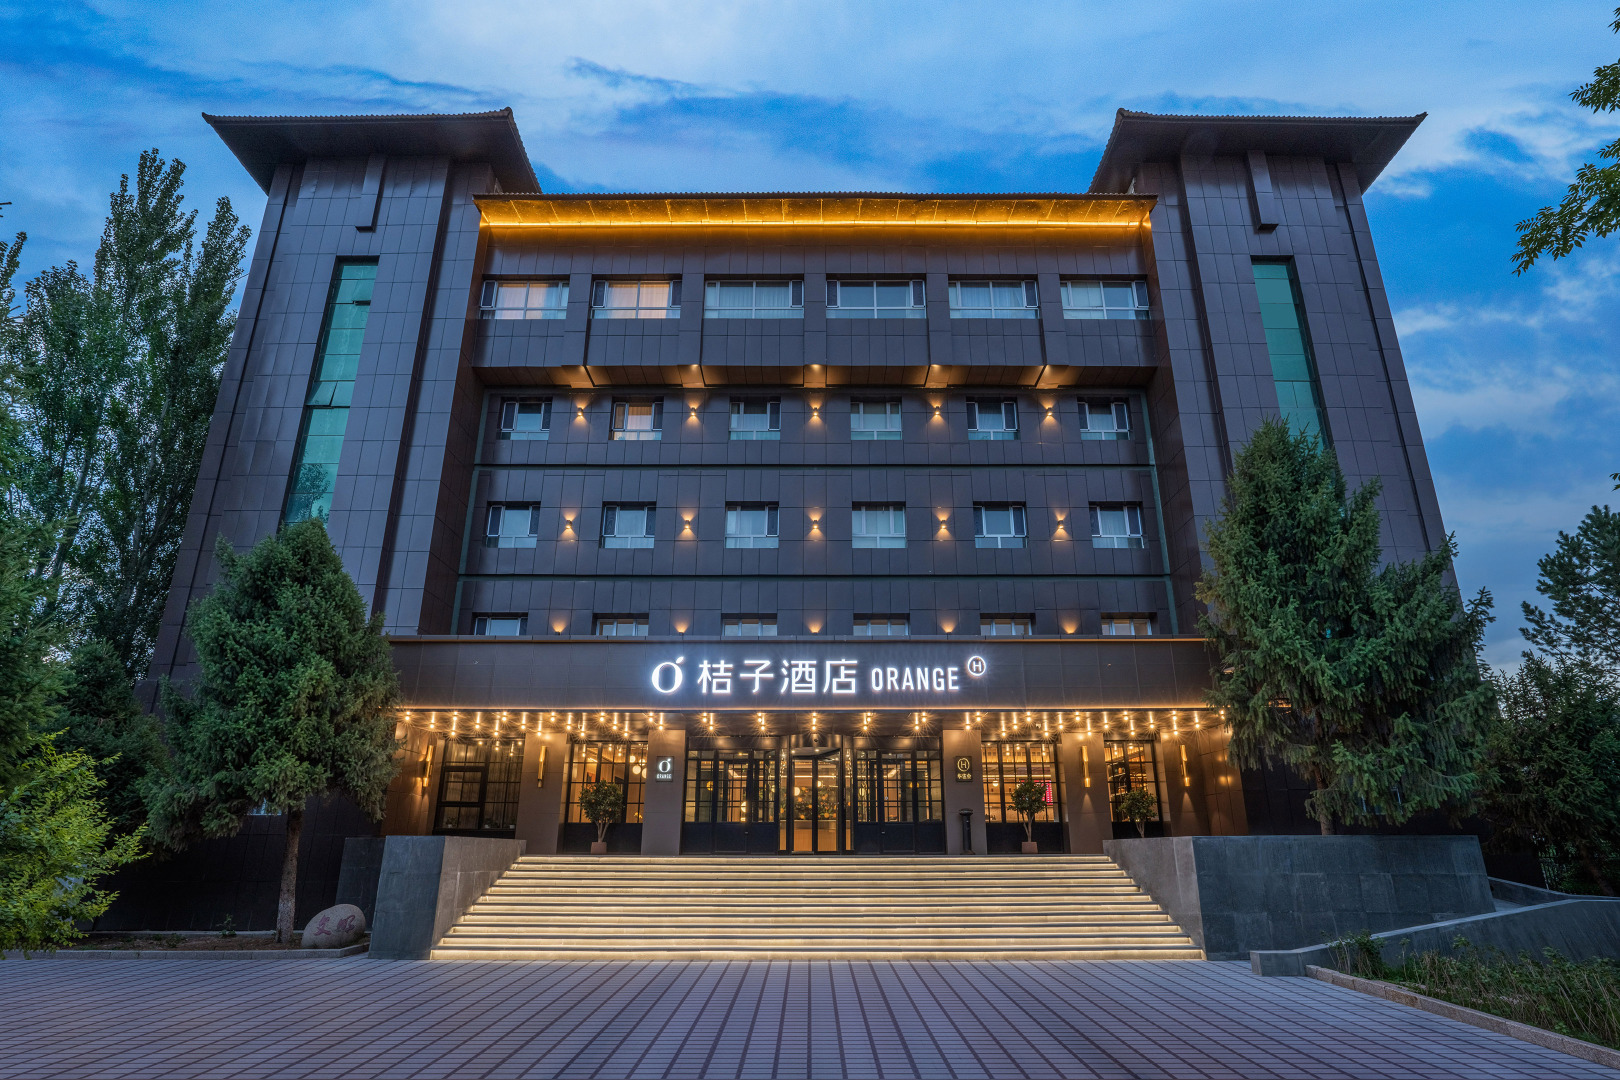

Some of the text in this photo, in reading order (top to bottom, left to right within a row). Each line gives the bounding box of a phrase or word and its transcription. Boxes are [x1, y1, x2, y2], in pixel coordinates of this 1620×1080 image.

[697, 659, 858, 694] 桔子酒店
[871, 667, 959, 691] ORANGE
